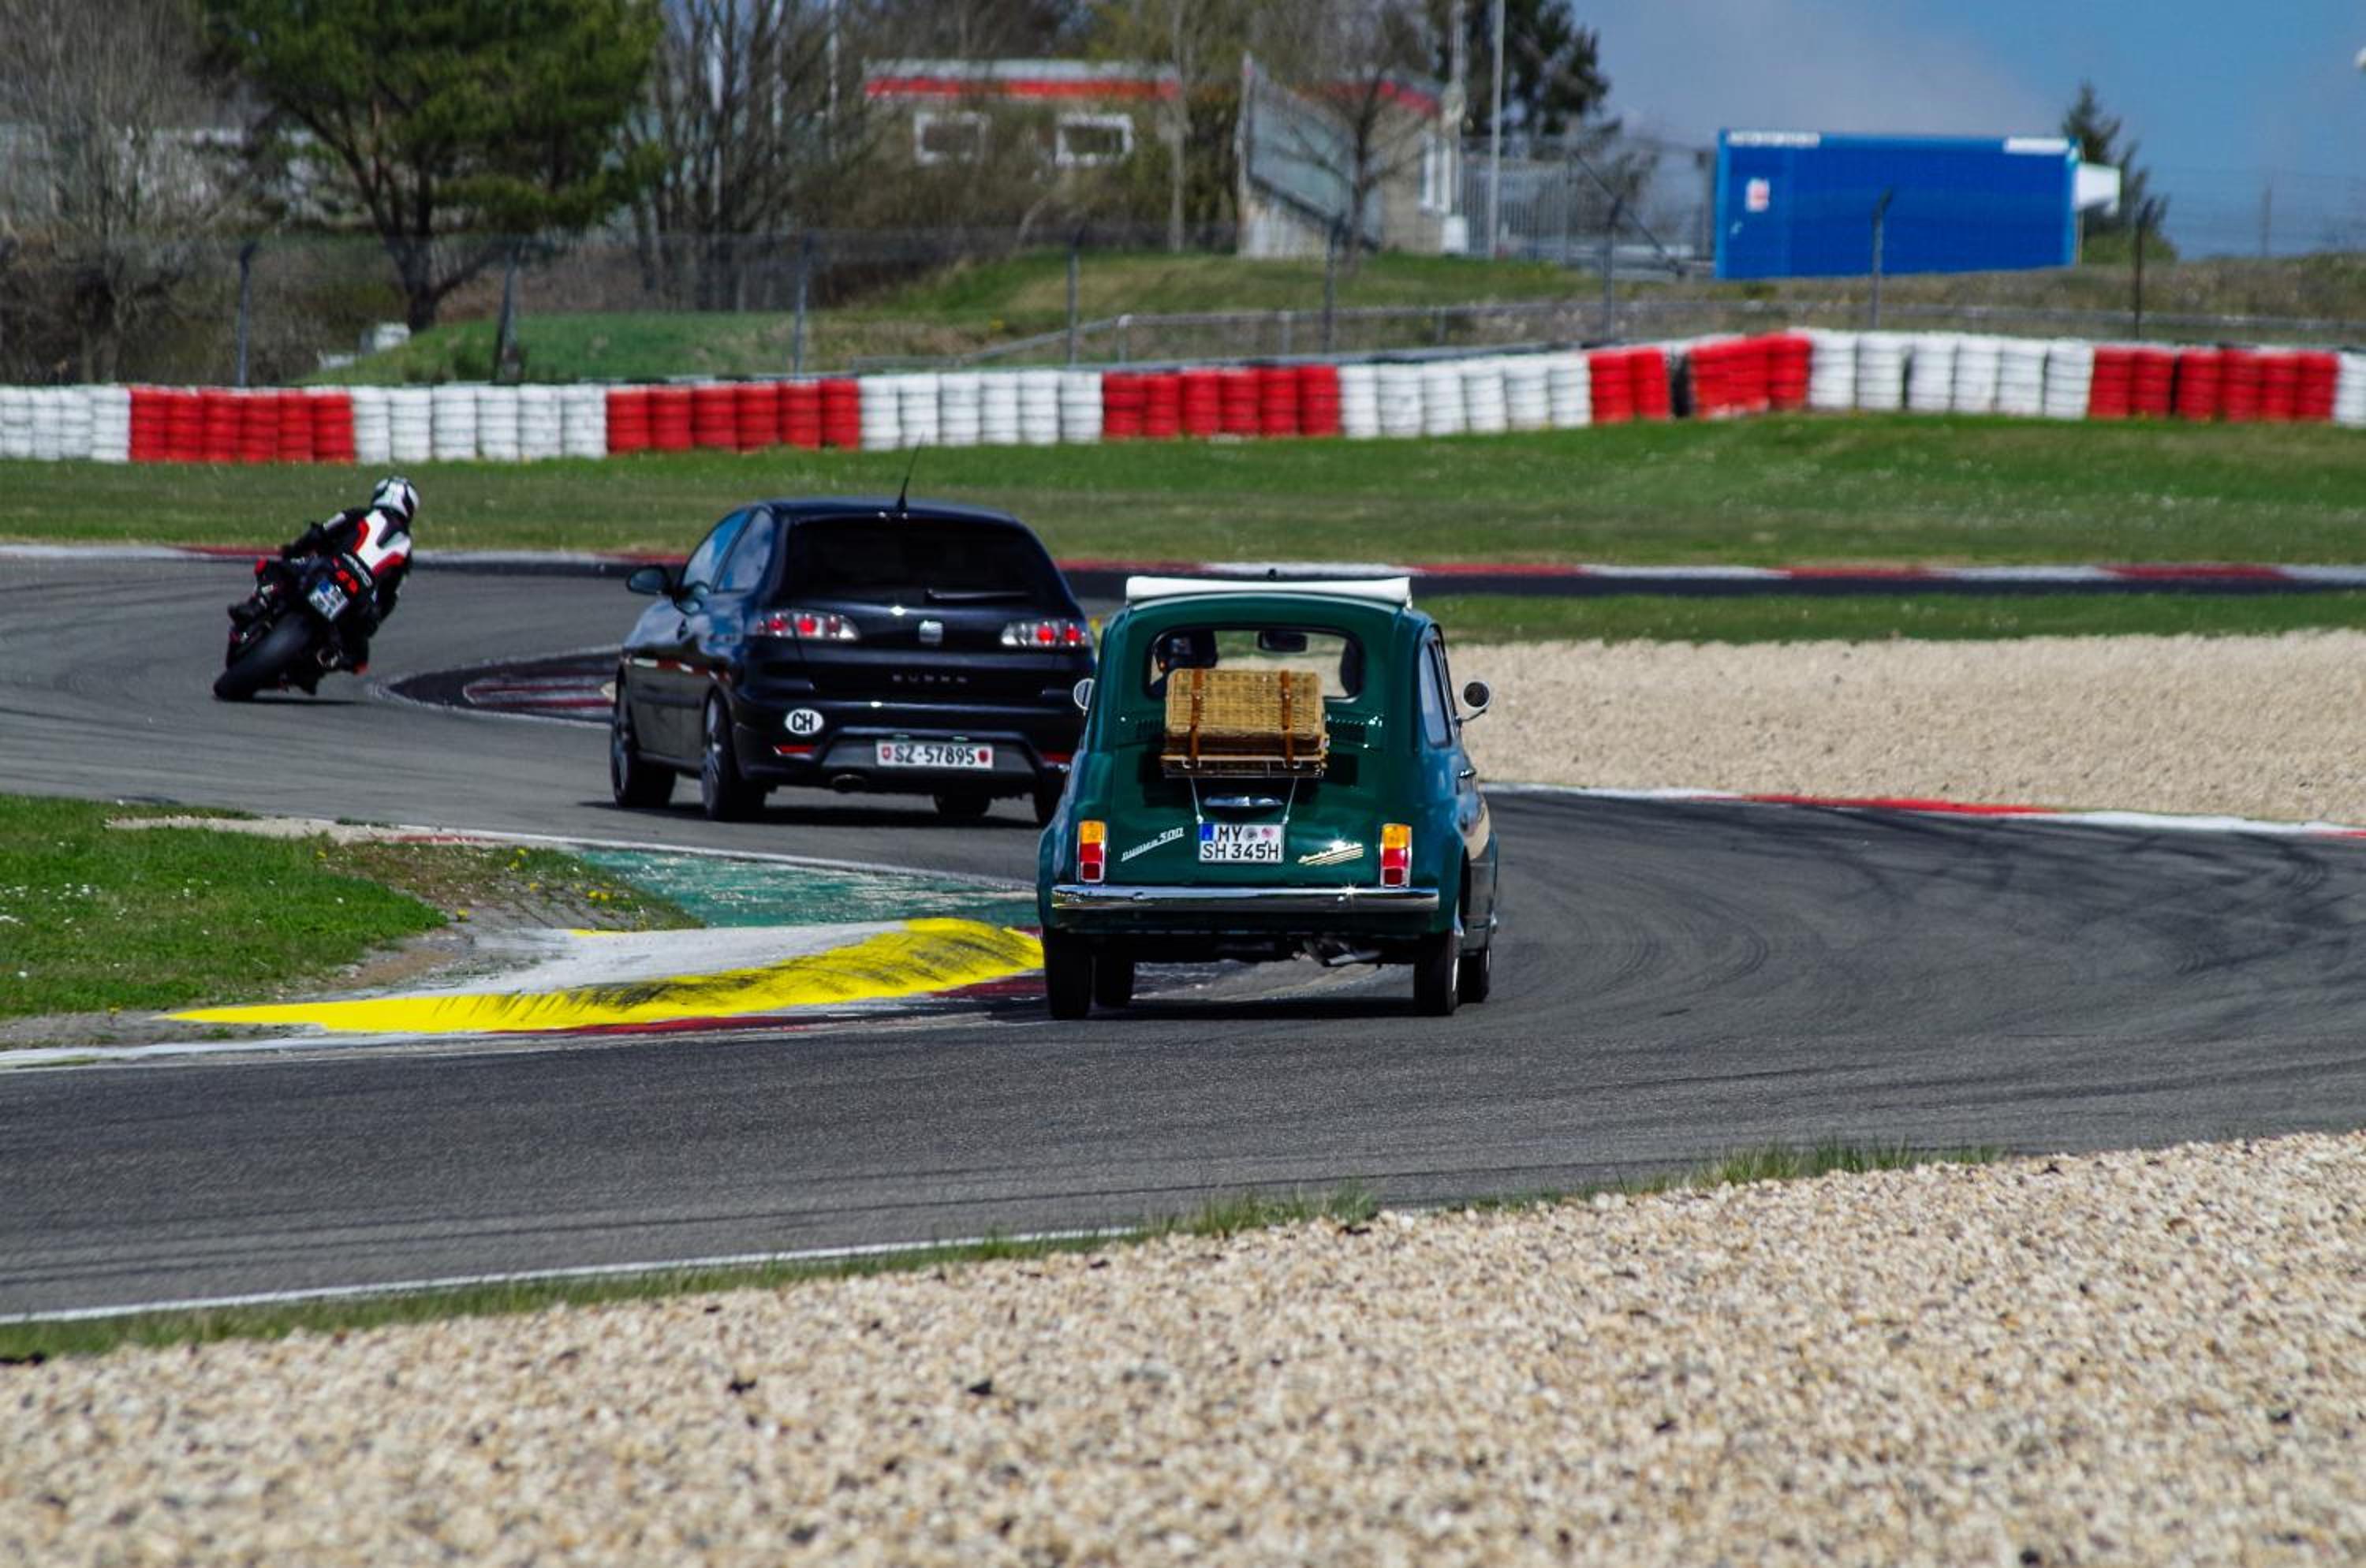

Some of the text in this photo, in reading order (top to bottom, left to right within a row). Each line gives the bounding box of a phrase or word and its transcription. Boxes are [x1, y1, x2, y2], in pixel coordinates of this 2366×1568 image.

[792, 711, 814, 731] CH
[1218, 825, 1243, 842] MY
[1203, 843, 1278, 859] SH 345H
